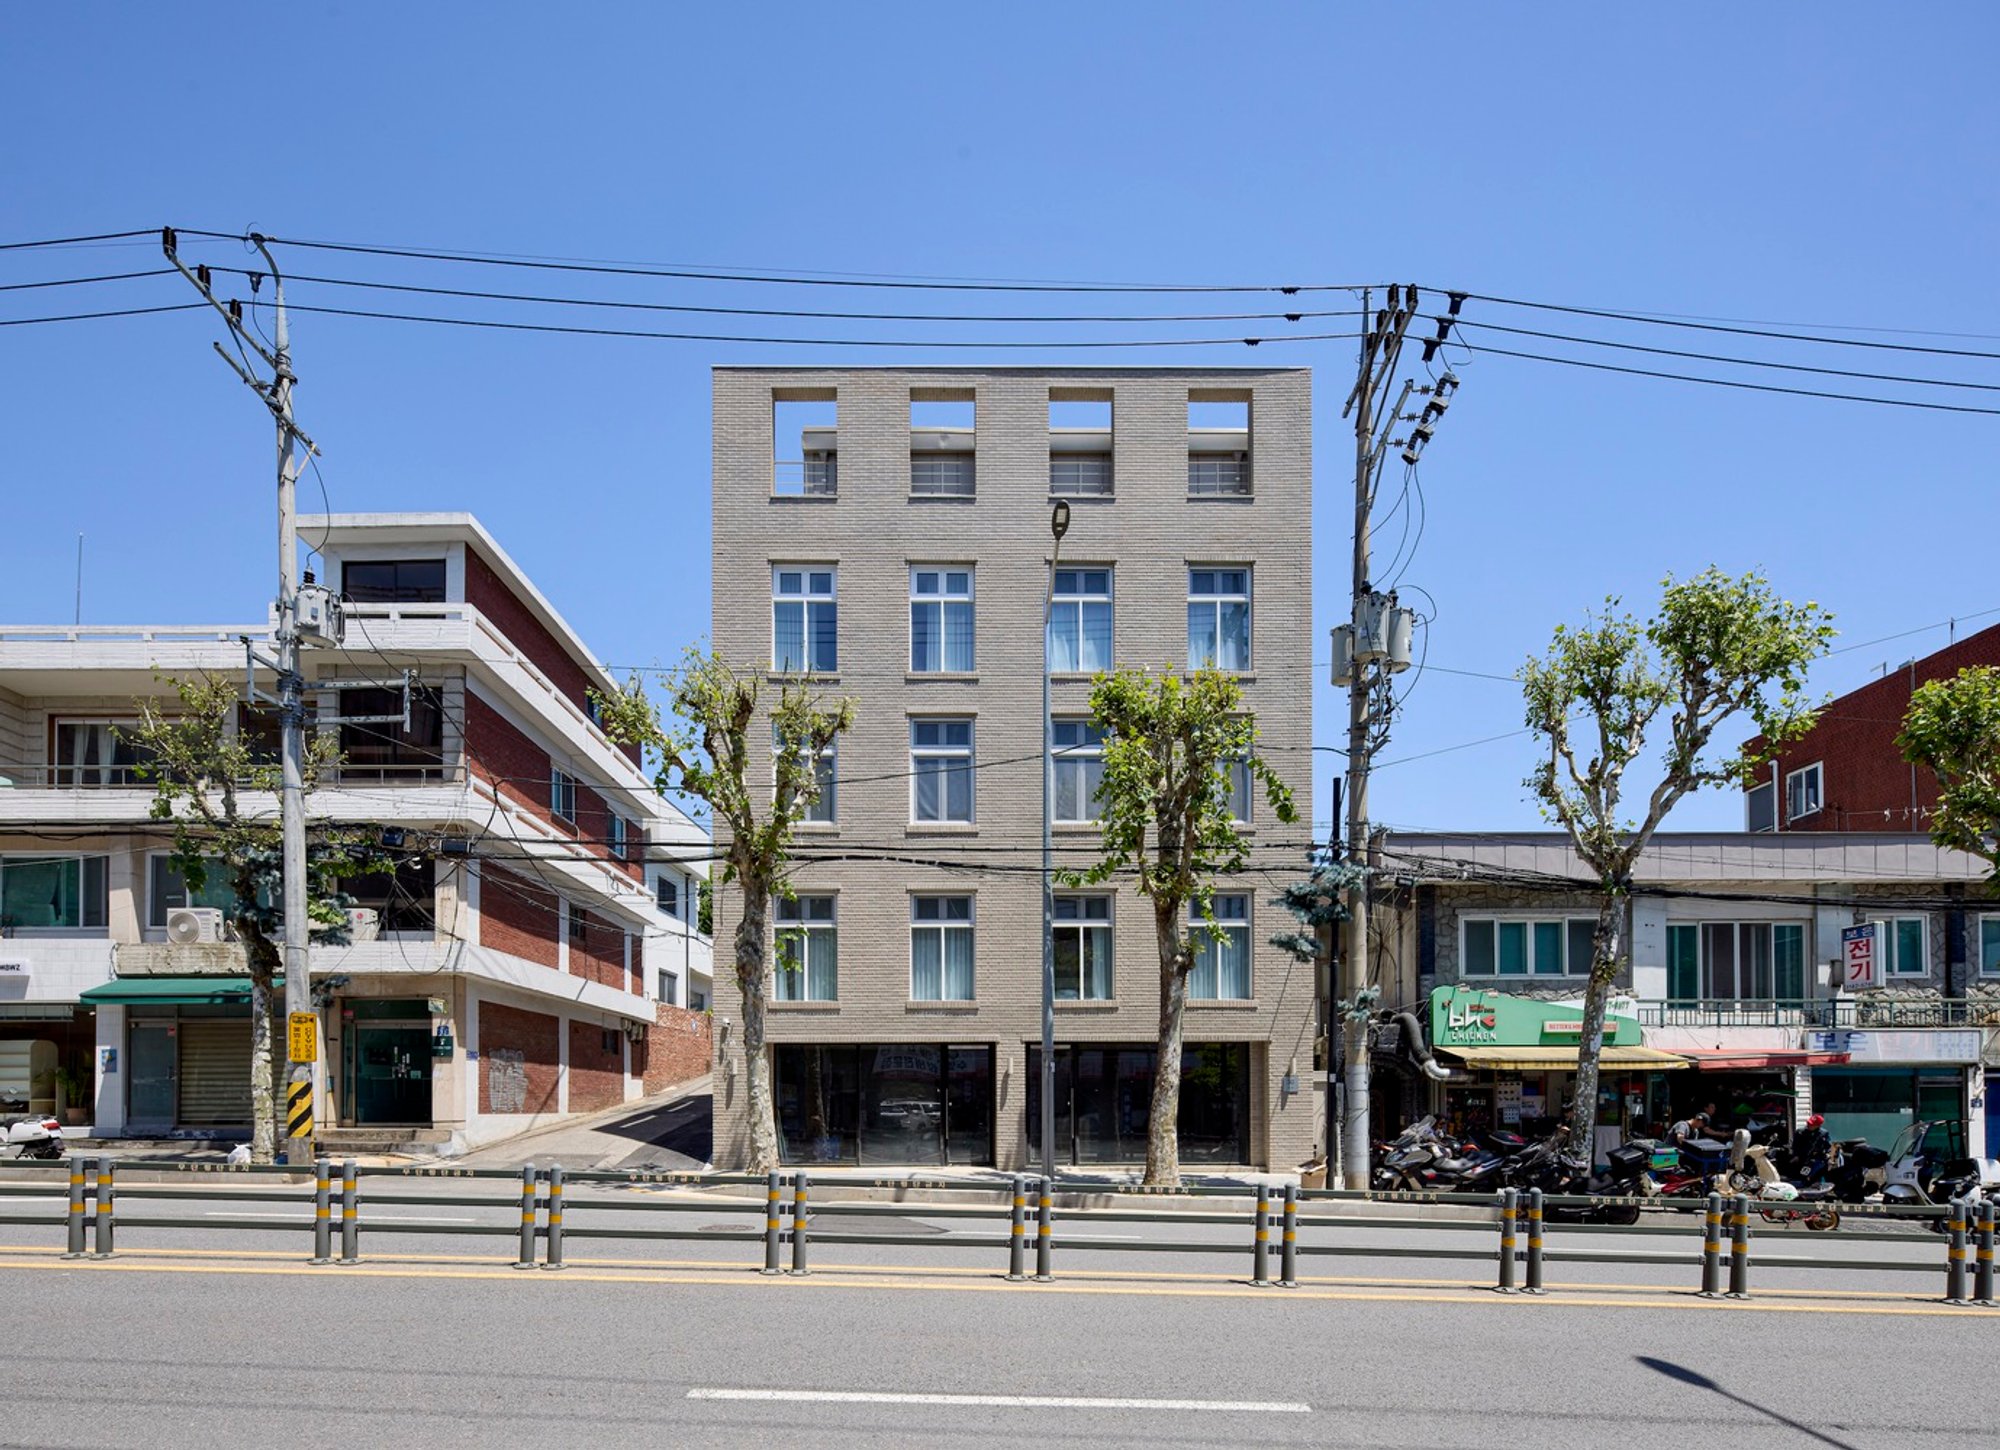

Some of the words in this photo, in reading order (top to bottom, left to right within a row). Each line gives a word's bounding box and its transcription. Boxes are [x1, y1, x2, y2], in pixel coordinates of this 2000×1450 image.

[1849, 938, 1871, 981] 전기
[1449, 1002, 1496, 1028] bhc
[1451, 1031, 1497, 1041] CHICKEN
[178, 1163, 249, 1172] 무단횡단금지
[402, 1168, 475, 1177] 무단횡단금지
[629, 1173, 702, 1183] 무단횡단금지
[874, 1180, 946, 1188] 무단횡단금지
[1118, 1185, 1189, 1194] 무단횡단금지
[1364, 1192, 1437, 1201] 무단횡단금지
[1590, 1197, 1661, 1206] 무단횡단금지
[1815, 1204, 1887, 1213] 무단횡단금지
